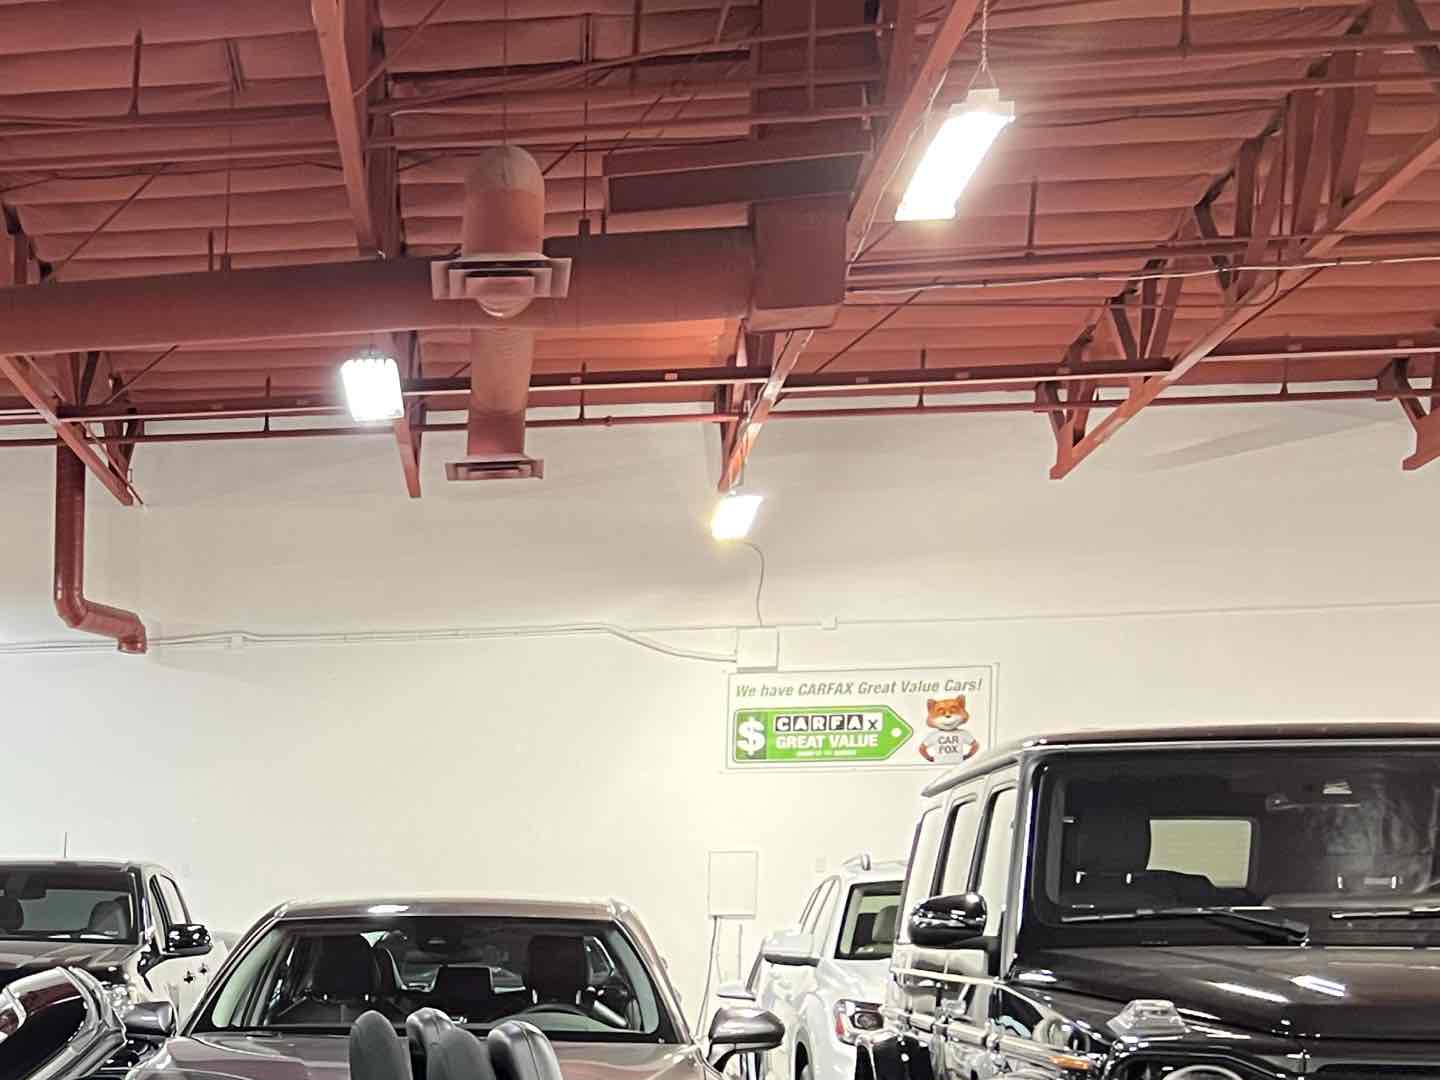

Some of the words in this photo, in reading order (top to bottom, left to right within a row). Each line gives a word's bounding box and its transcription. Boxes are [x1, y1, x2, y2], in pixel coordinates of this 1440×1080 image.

[736, 684, 756, 697] We
[760, 683, 794, 697] have
[798, 682, 854, 696] CARFAX
[858, 680, 897, 694] Great
[901, 680, 940, 693] Value
[944, 678, 983, 692] Cars!
[775, 735, 823, 750] GREAT
[830, 734, 879, 748] VALUE
[938, 735, 959, 745] CAR
[938, 745, 958, 754] FOX
